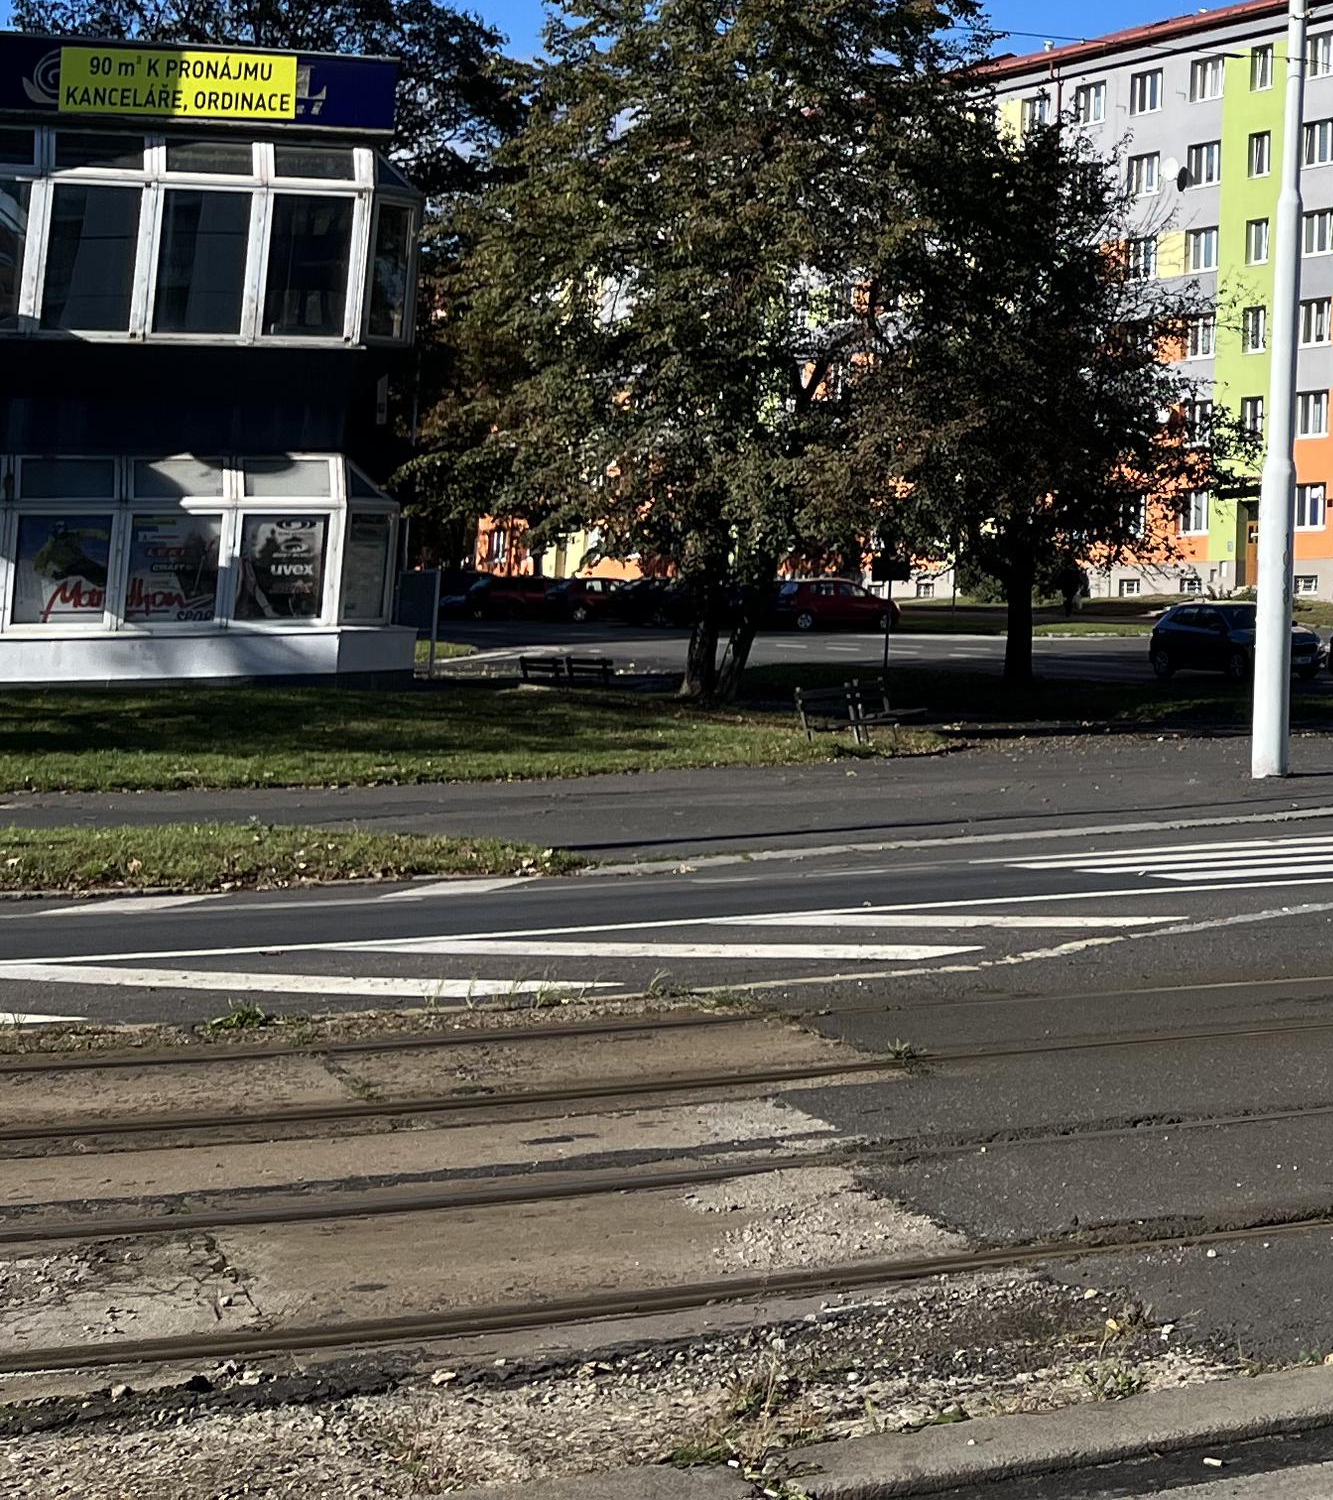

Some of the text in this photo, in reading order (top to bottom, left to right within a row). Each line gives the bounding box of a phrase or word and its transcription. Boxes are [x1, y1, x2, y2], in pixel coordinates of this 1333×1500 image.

[89, 56, 112, 76] 90
[147, 59, 159, 78] K
[166, 56, 273, 81] PRONÁJMU
[66, 85, 188, 112] KANCELÁŘE,
[194, 91, 291, 112] ORDINACE
[270, 564, 313, 576] uvex
